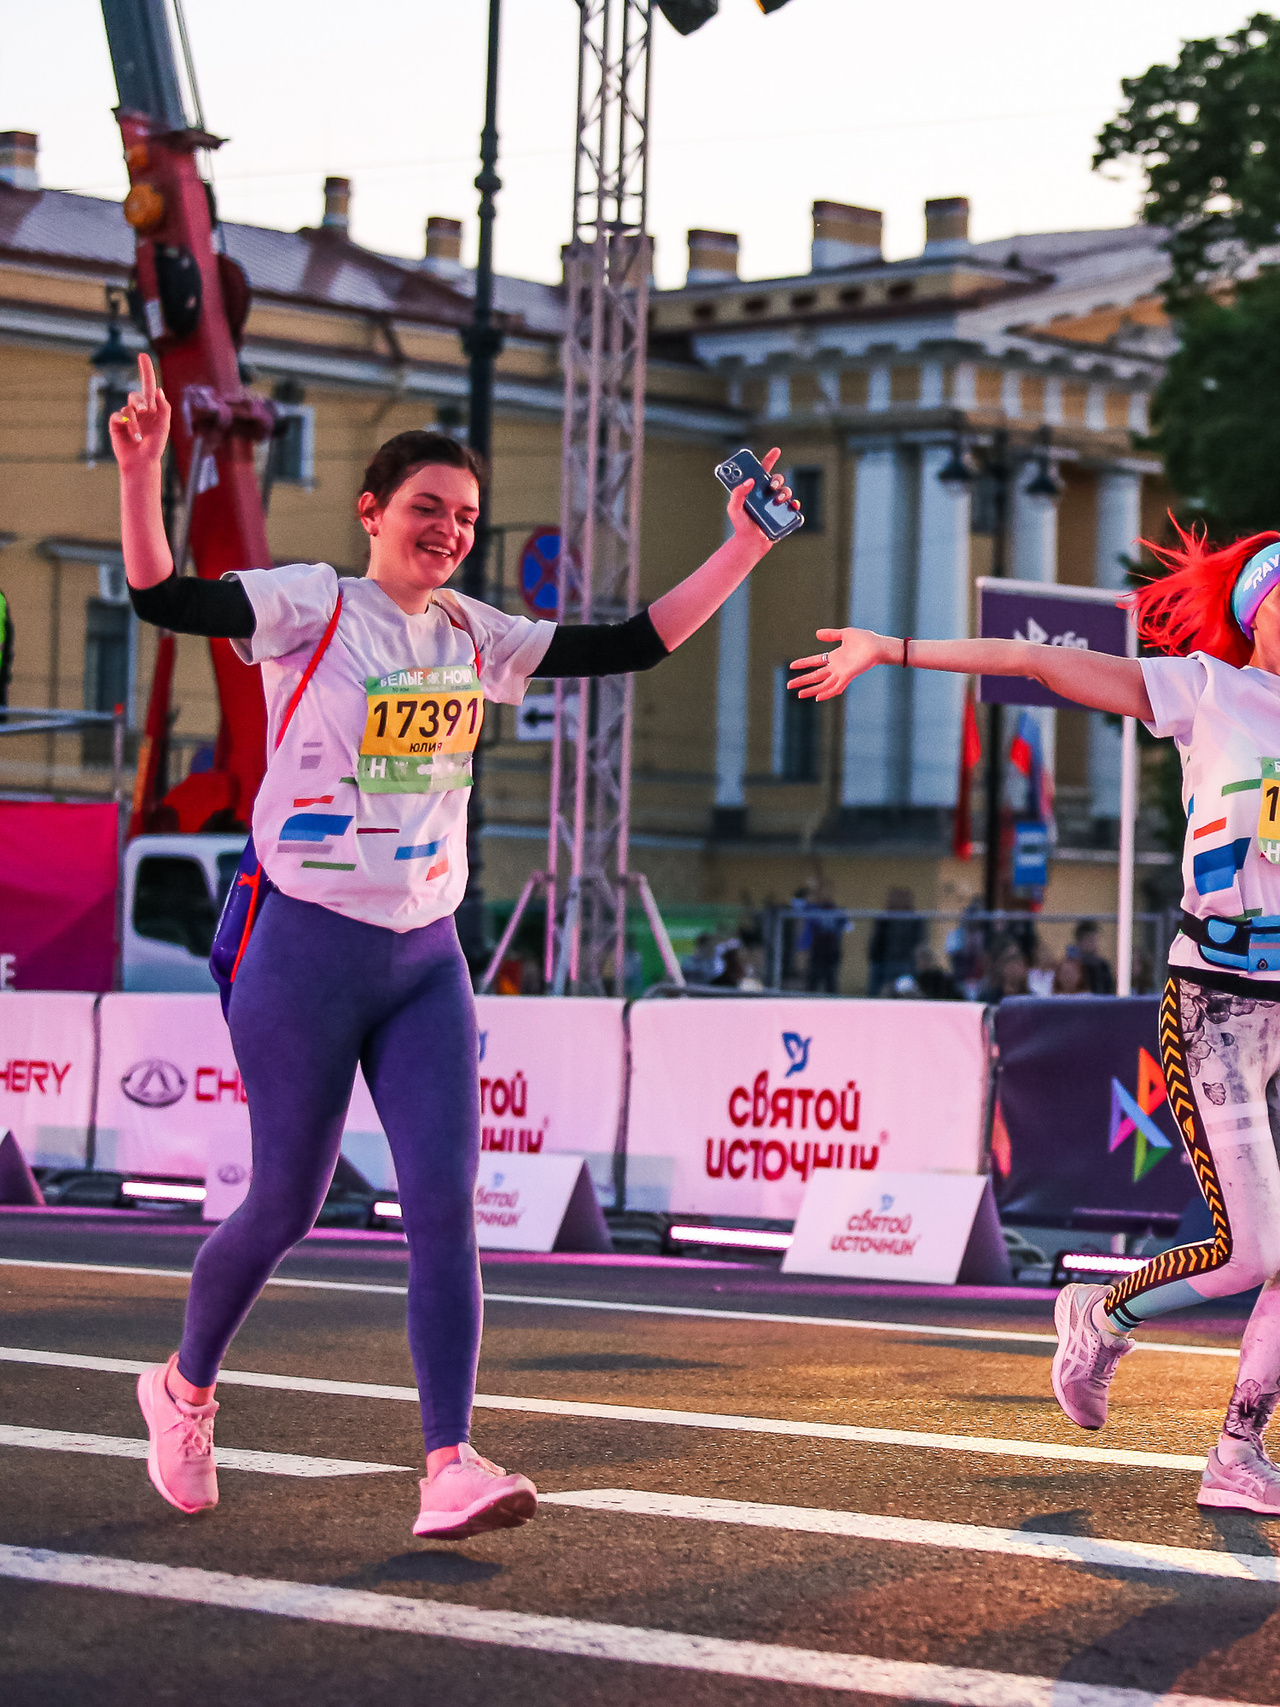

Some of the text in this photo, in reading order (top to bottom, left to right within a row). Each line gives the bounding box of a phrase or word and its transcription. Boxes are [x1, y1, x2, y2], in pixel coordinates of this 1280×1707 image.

[380, 671, 424, 687] БЕЛЫЕ
[374, 697, 478, 738] 17391
[409, 742, 442, 753] ЮЛИЯ
[196, 1066, 248, 1102] CH
